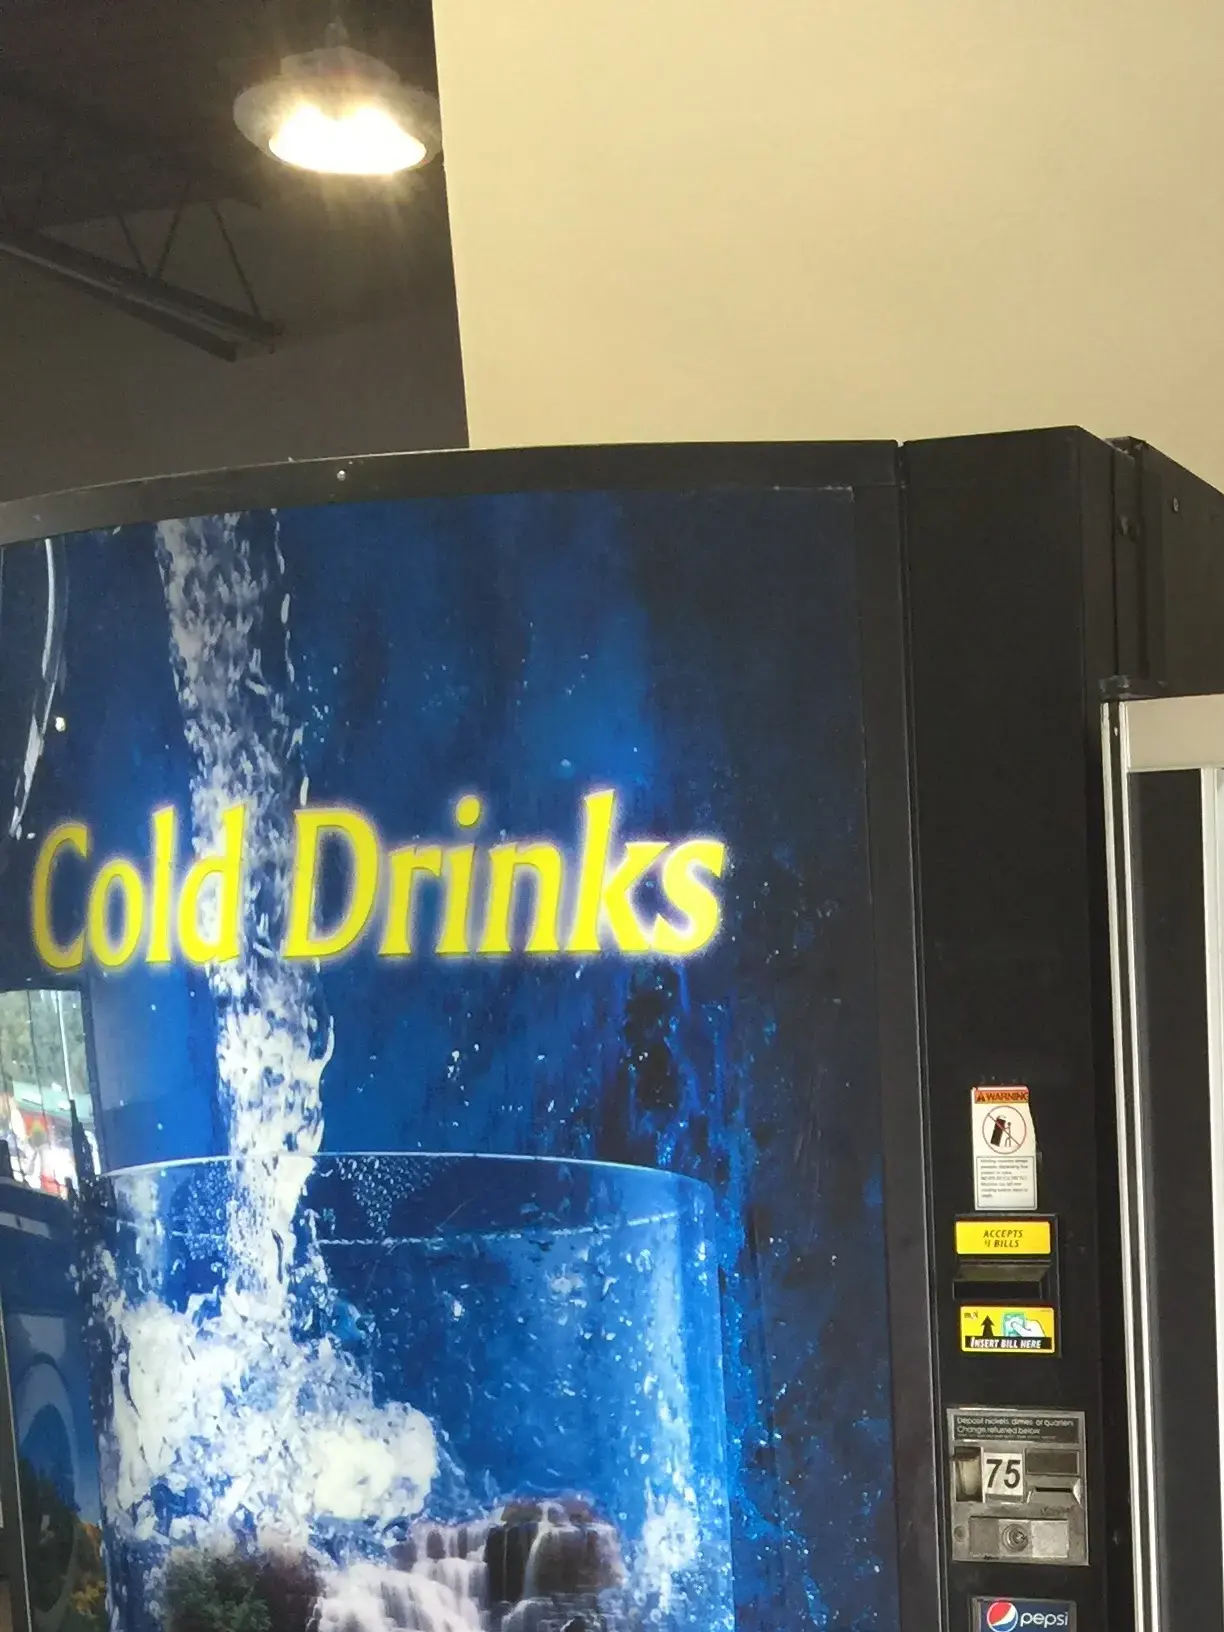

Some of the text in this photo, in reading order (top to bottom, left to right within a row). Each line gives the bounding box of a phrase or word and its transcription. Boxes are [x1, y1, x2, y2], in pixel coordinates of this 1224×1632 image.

[31, 789, 725, 969] Cold Drinks
[983, 1229, 1023, 1238] ACCEPTS
[994, 1239, 1020, 1248] BILLS
[970, 1337, 1042, 1349] INSERT BILL HERE
[986, 1459, 1021, 1489] 75
[1020, 1612, 1068, 1628] pepsi
